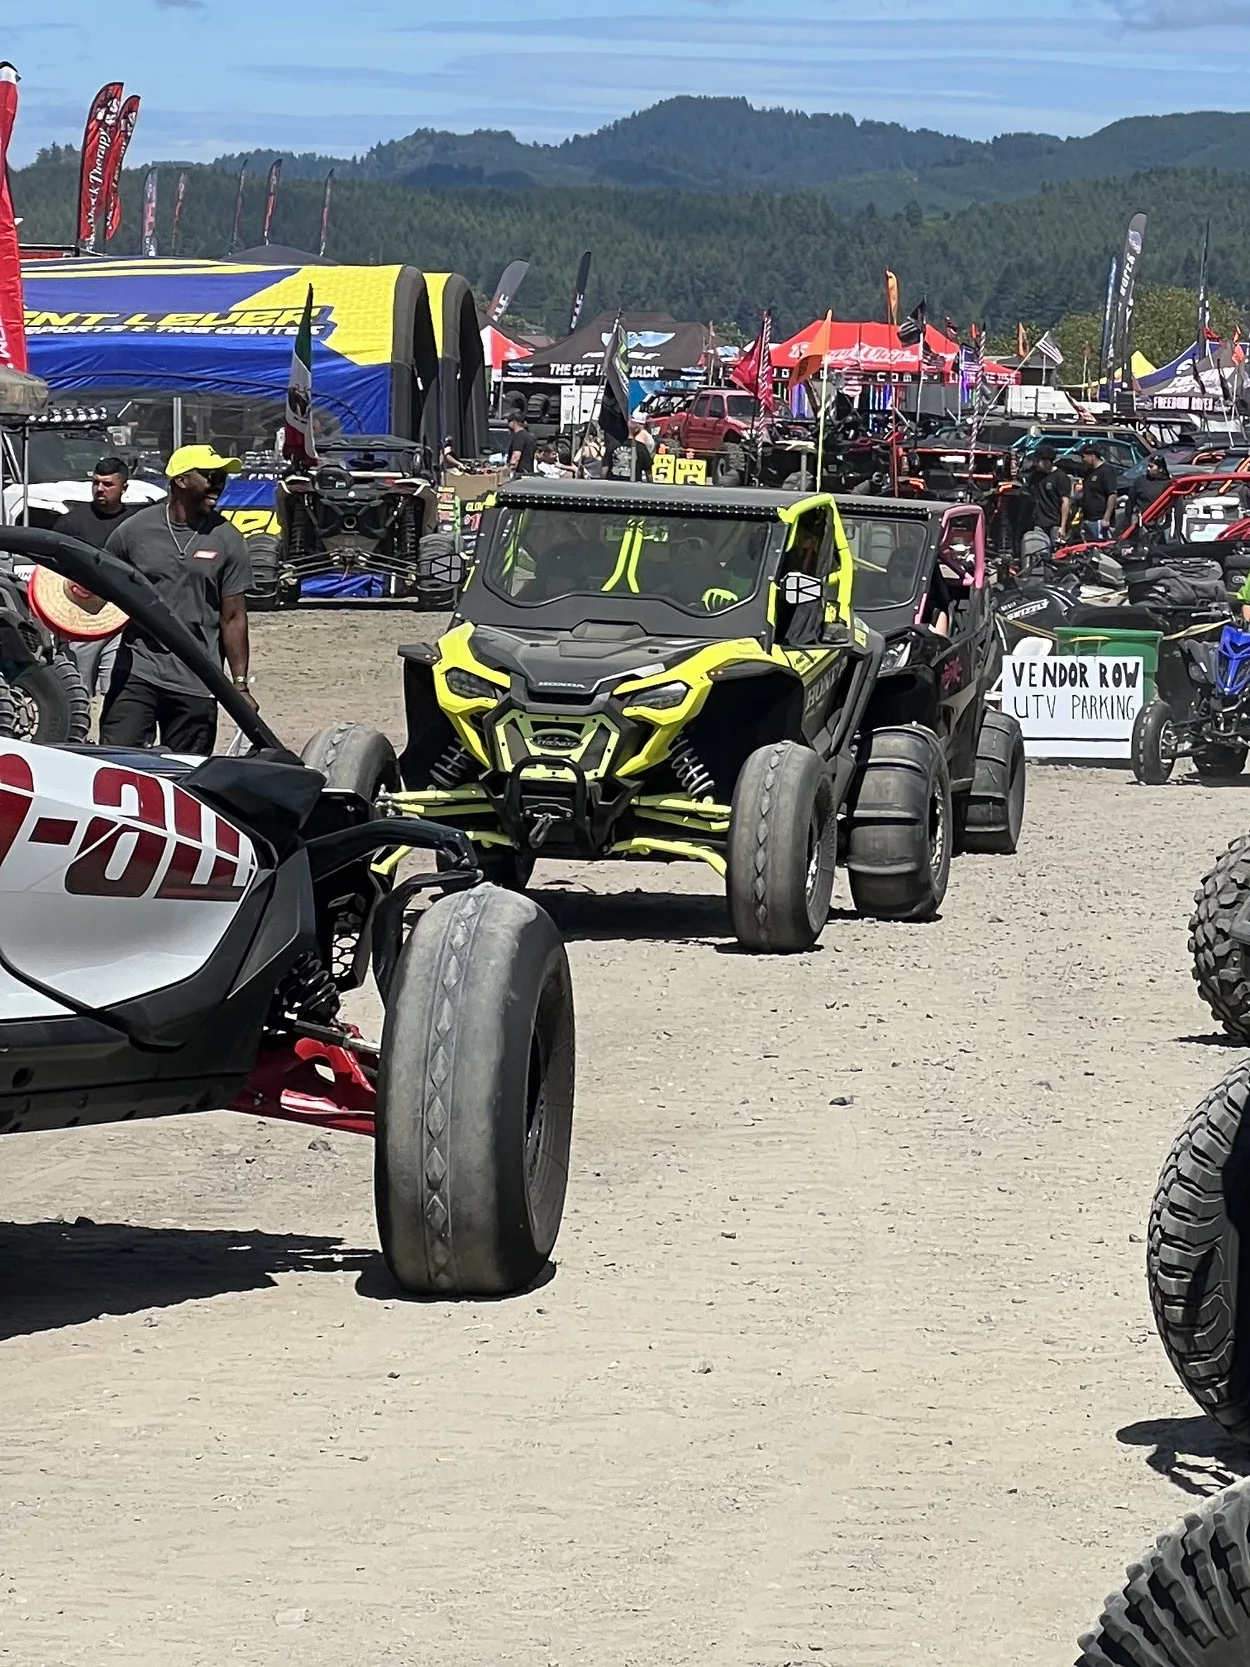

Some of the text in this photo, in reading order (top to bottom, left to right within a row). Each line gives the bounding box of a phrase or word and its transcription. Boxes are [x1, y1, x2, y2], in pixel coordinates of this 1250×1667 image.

[123, 306, 320, 326] LEVER
[549, 363, 572, 376] THE
[572, 364, 595, 376] OFF
[629, 365, 660, 378] JACK
[1006, 598, 1050, 621] GRIZZLY
[537, 681, 586, 689] HONDA
[1012, 662, 1140, 688] VENDOR ROW
[1013, 694, 1135, 720] UTV PARKING
